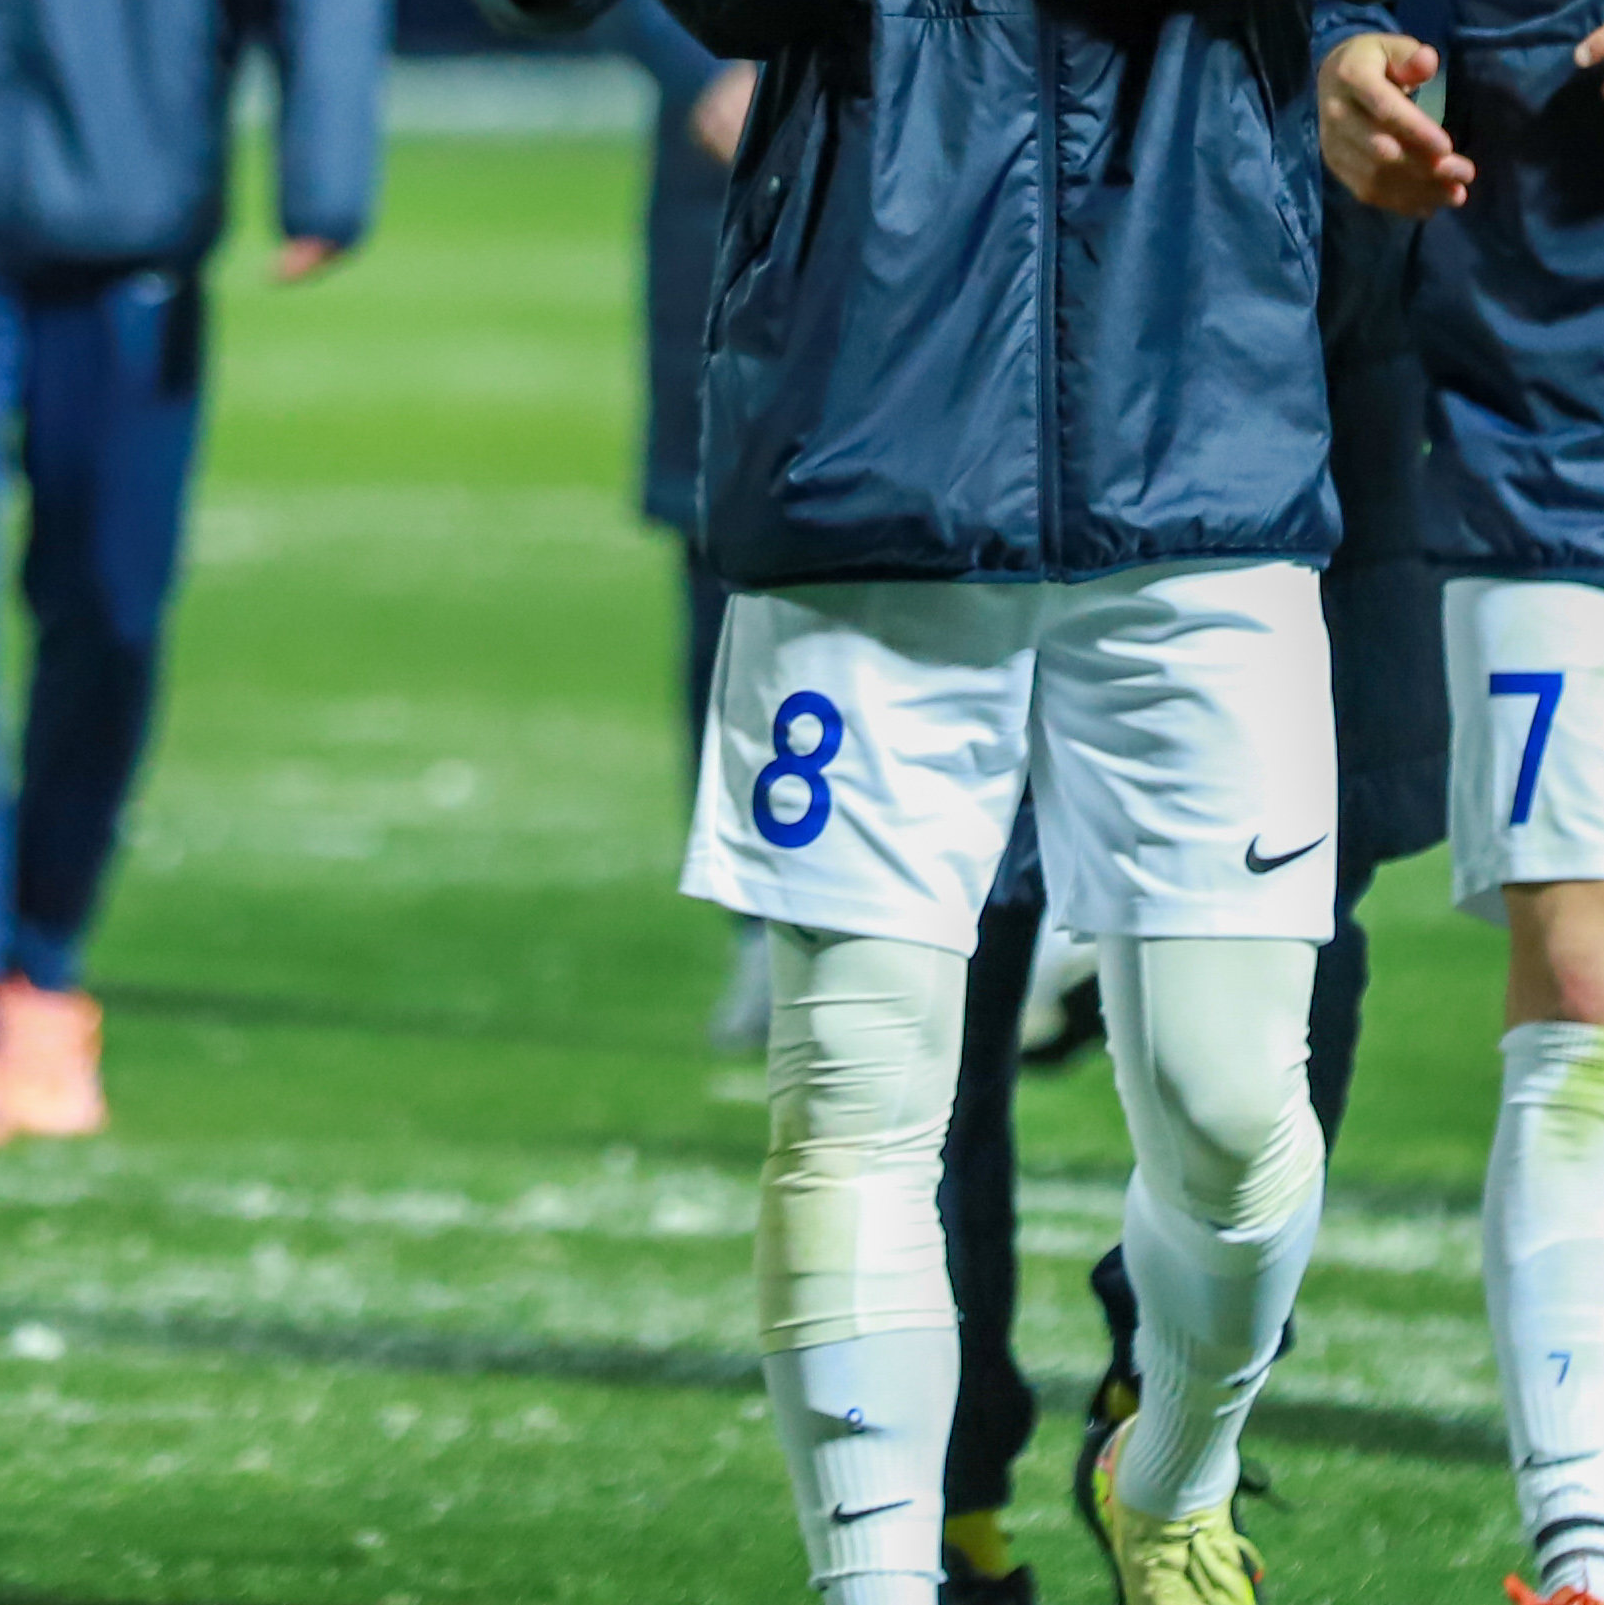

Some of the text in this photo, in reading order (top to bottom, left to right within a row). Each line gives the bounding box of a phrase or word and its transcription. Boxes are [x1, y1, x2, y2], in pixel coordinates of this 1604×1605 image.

[752, 689, 845, 849] 8
[1489, 671, 1565, 826] 7
[1546, 1350, 1572, 1386] 7
